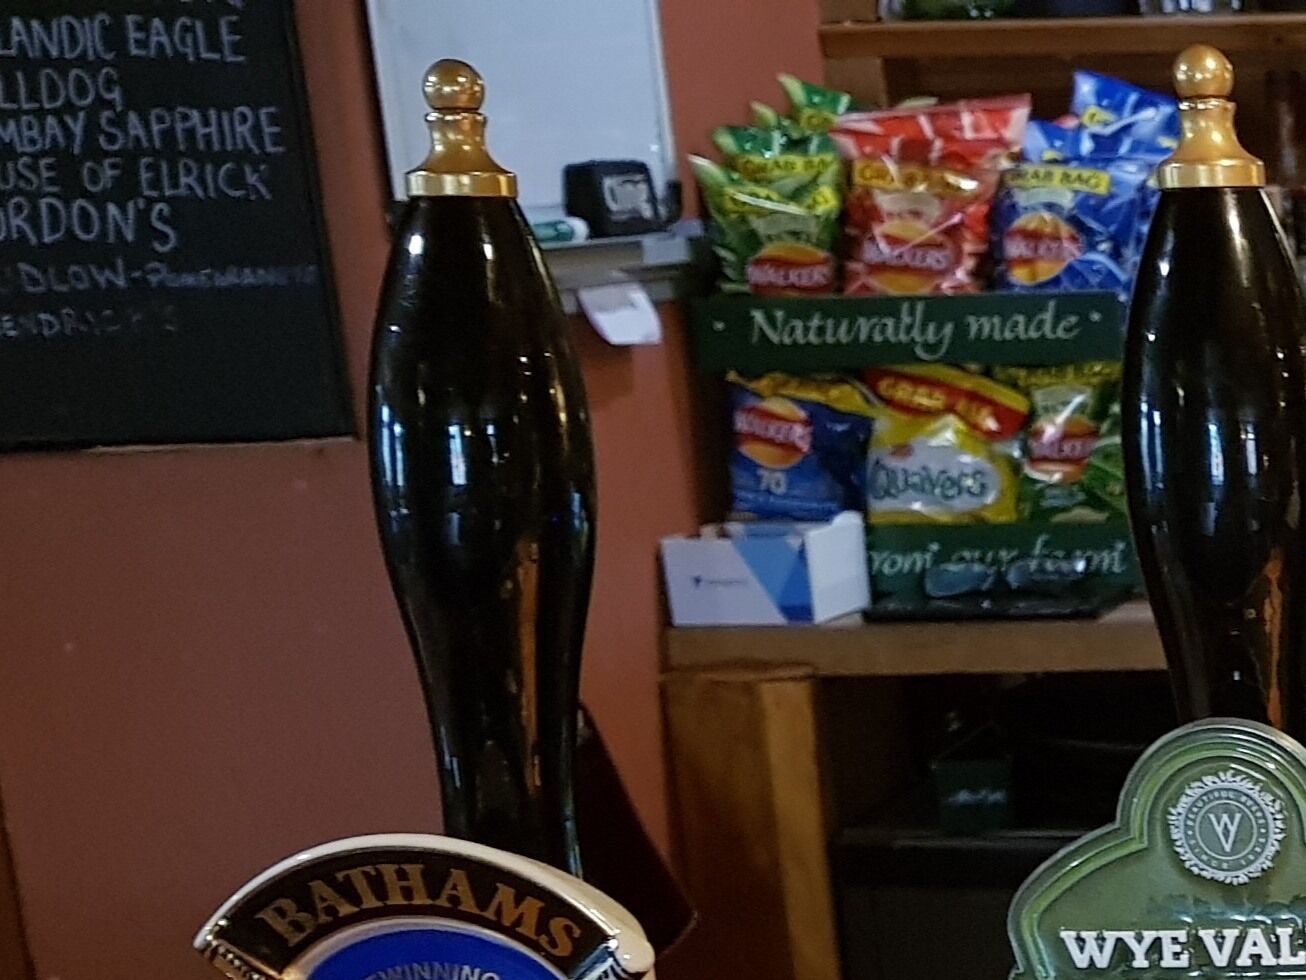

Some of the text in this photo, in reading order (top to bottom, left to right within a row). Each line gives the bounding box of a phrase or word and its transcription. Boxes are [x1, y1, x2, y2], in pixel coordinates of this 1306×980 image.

[126, 14, 247, 62] EAGLE
[99, 106, 286, 154] SAPPHIRE
[83, 158, 122, 192] OF
[140, 158, 272, 200] ELRICK
[749, 300, 1081, 361] Naturally made
[870, 459, 987, 500] Quavers
[254, 862, 583, 959] BATHAMS
[1060, 927, 1191, 969] WYE
